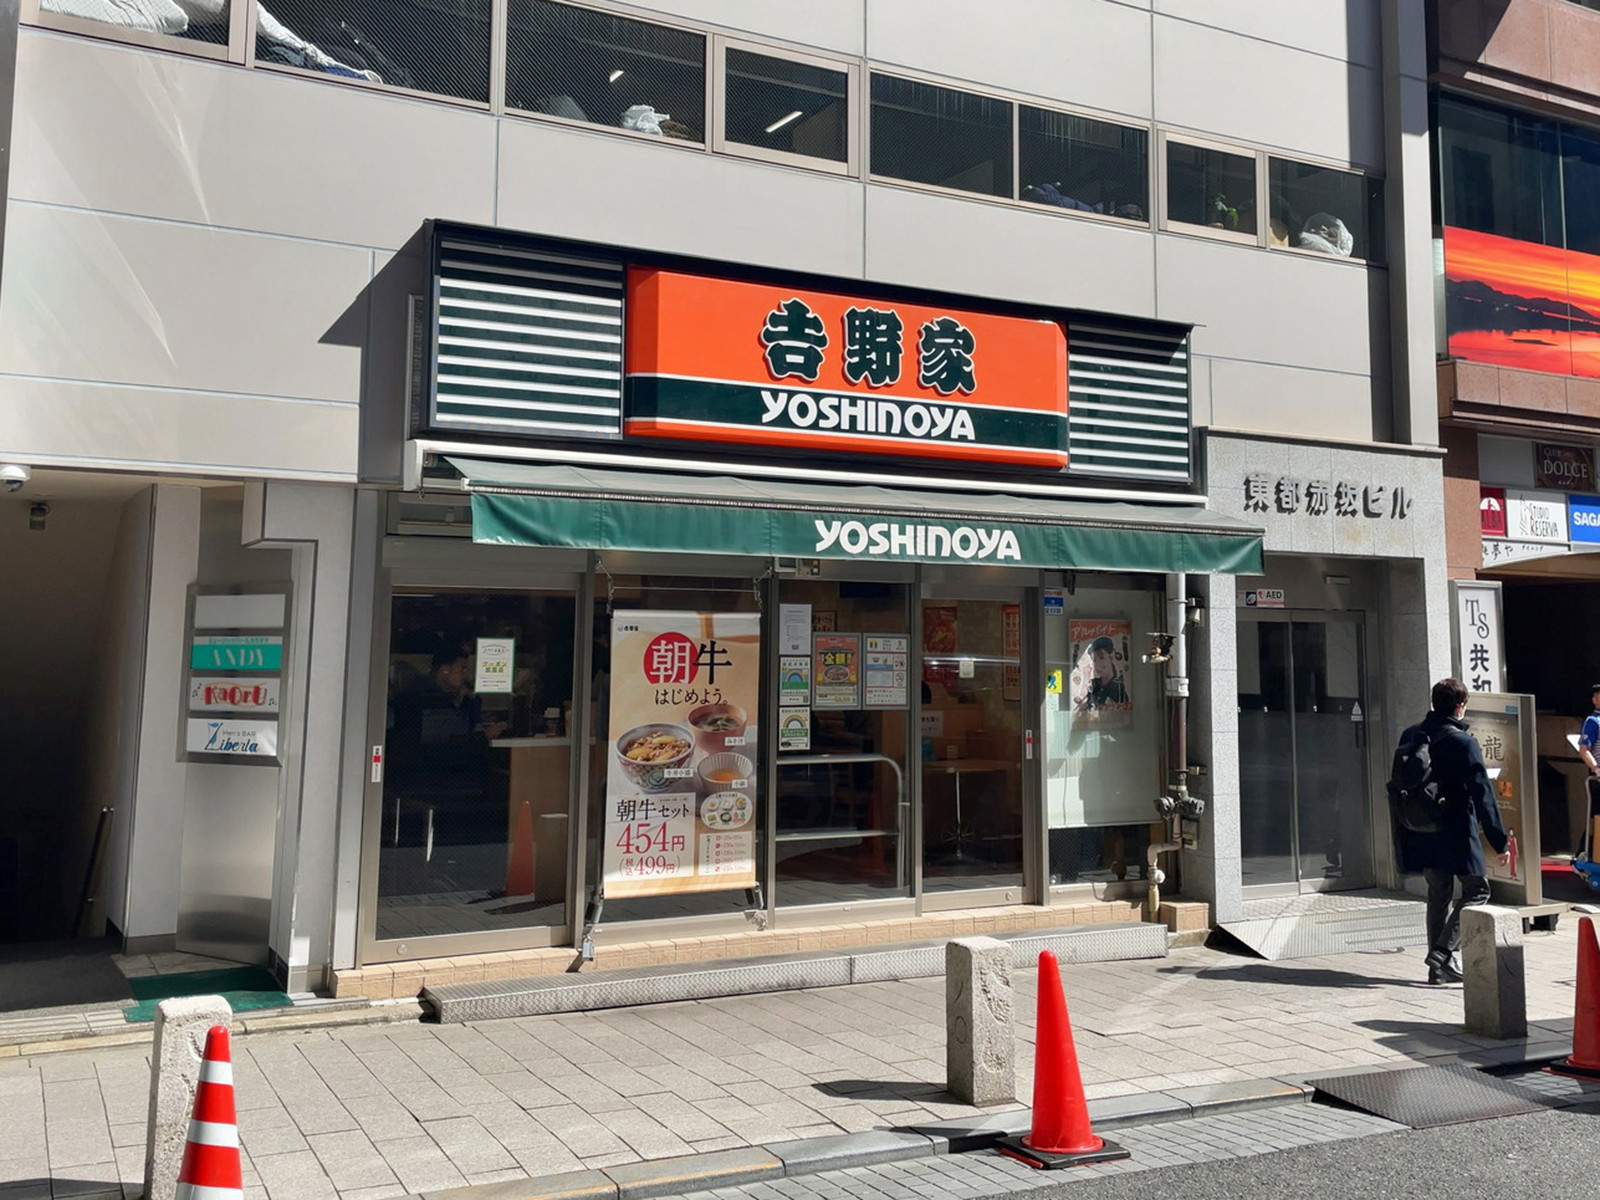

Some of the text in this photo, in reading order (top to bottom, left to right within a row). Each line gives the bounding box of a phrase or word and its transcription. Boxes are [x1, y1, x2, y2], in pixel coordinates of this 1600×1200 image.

[758, 298, 977, 396] 吉野家
[760, 389, 976, 441] YOSHINOYA
[1544, 460, 1588, 478] DOLCE
[1243, 474, 1412, 520] 東都赤坂ビル
[815, 519, 1021, 561] YOSHINOYA
[1529, 517, 1559, 538] RESERVA
[1265, 591, 1282, 599] AED
[650, 639, 733, 685] 朝牛
[655, 688, 728, 705] はじめよう。
[616, 799, 690, 822] 朝牛セット
[616, 822, 686, 854] 454円
